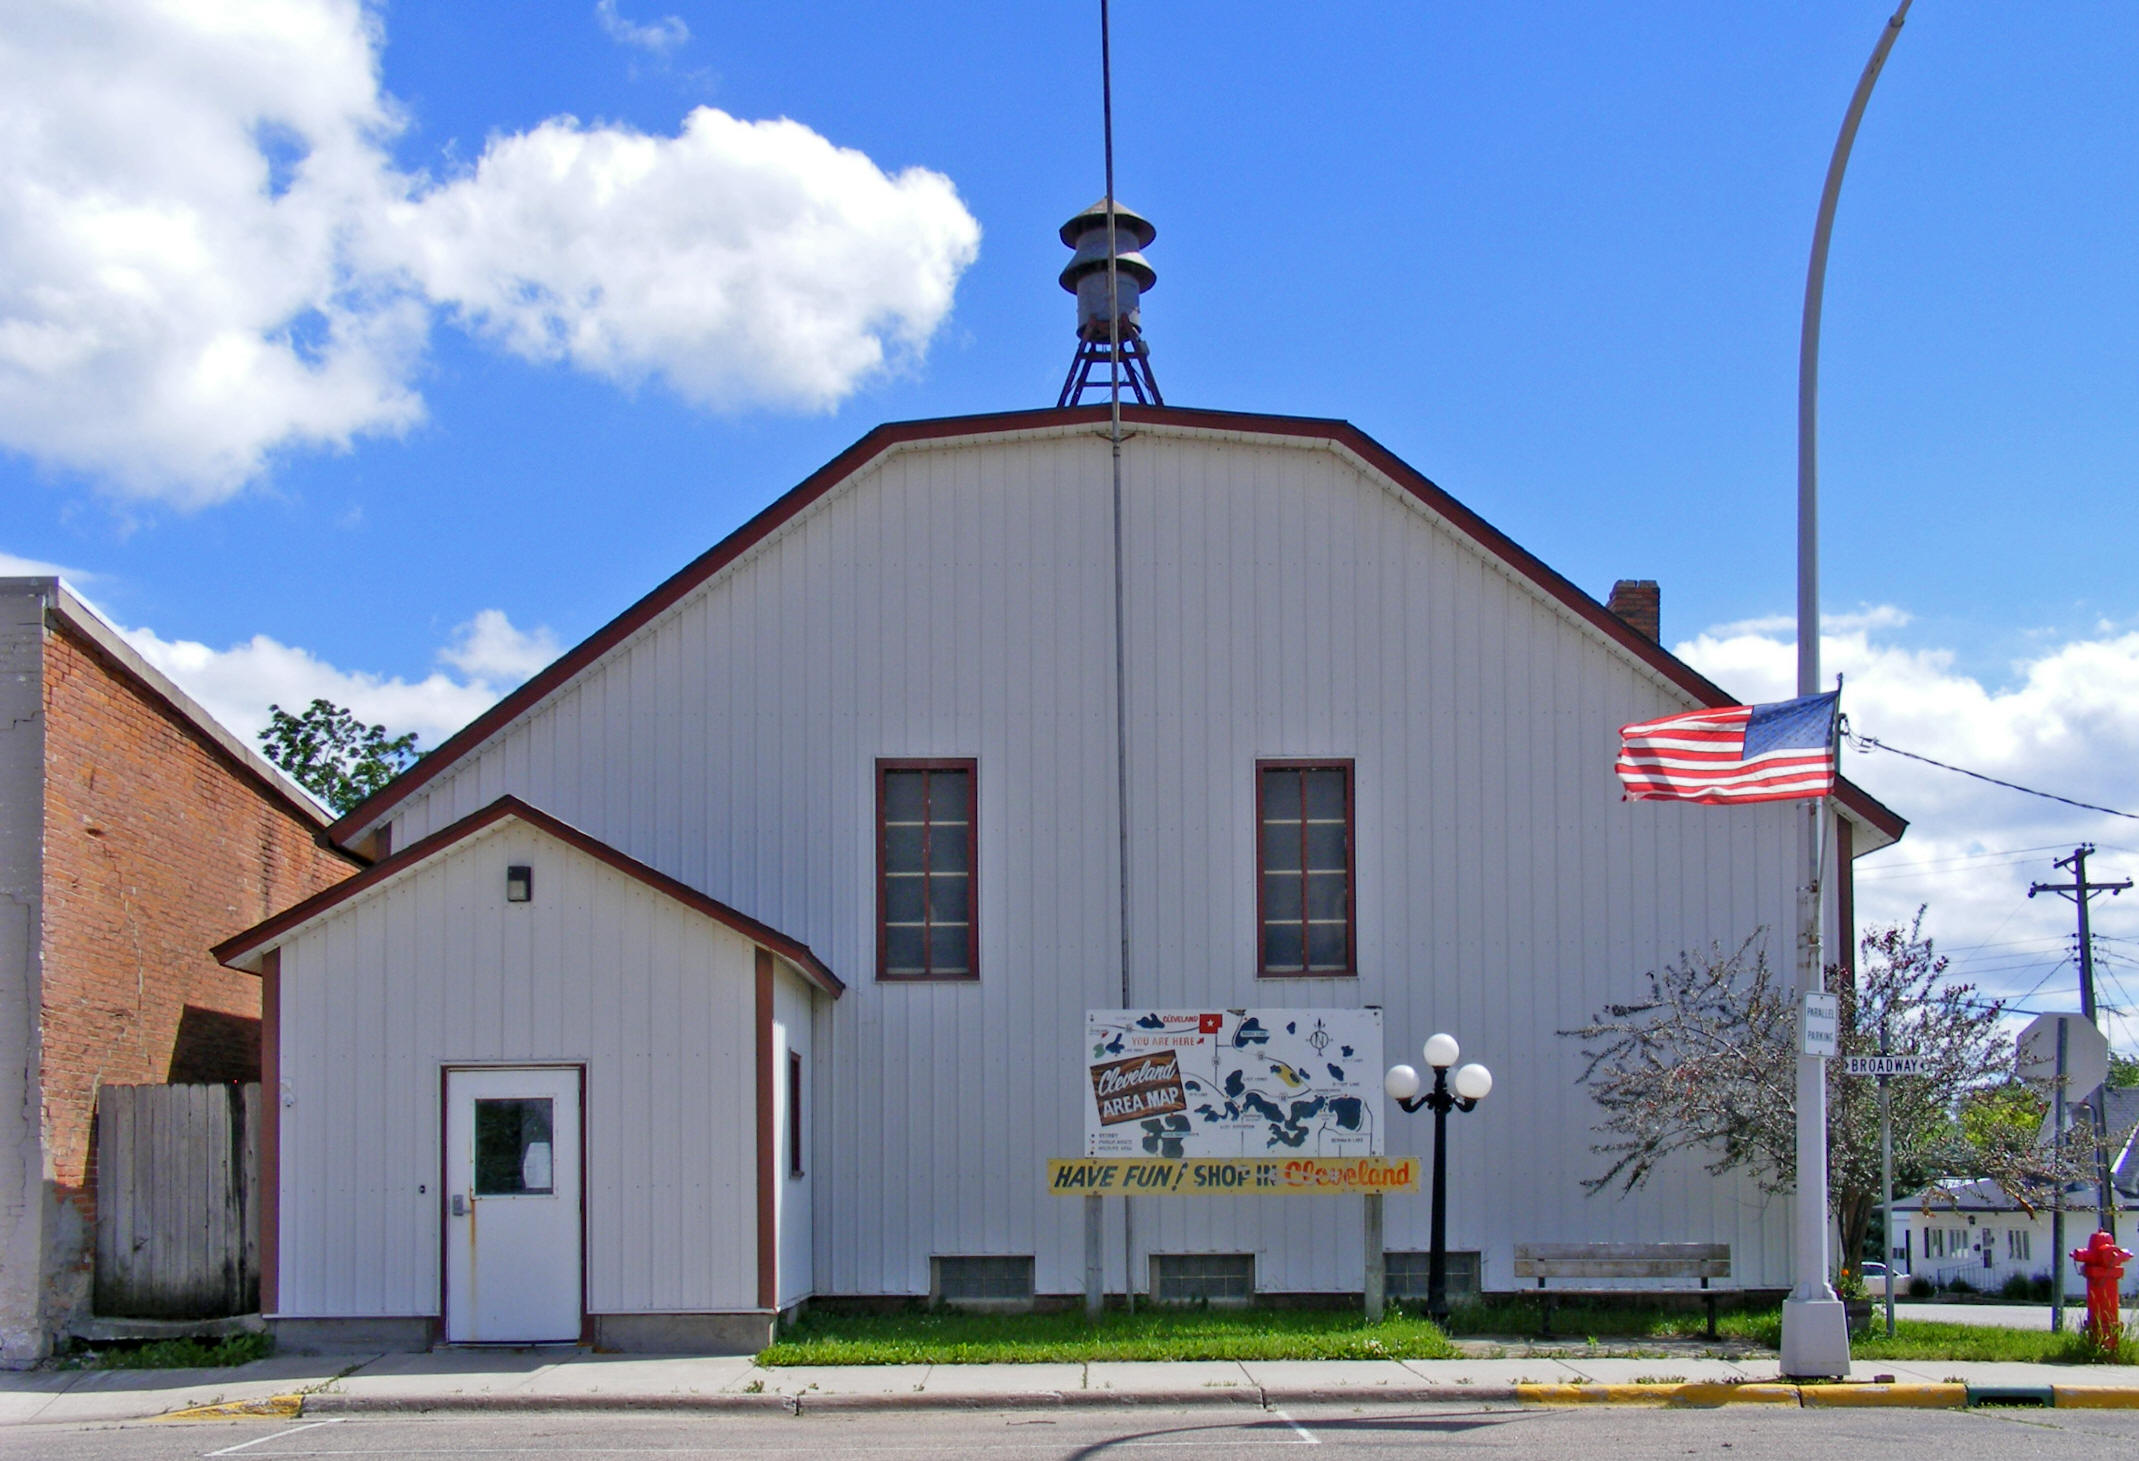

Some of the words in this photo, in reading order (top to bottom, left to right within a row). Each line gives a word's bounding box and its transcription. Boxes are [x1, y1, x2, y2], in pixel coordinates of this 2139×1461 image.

[1163, 1015, 1198, 1024] CLEVELAND
[1807, 1007, 1835, 1019] PARALLEL
[1132, 1037, 1150, 1046] YOU
[1152, 1037, 1169, 1046] ARE
[1173, 1037, 1195, 1046] HERE
[1807, 1031, 1834, 1042] PARKING
[1851, 1058, 1918, 1073] BROADWAY
[1098, 1058, 1177, 1097] Cleveland
[1103, 1094, 1144, 1118] AREA
[1146, 1087, 1179, 1108] MAP
[1054, 1166, 1117, 1188] HAVE
[1194, 1165, 1250, 1187] SHOP
[1256, 1166, 1277, 1187] IN
